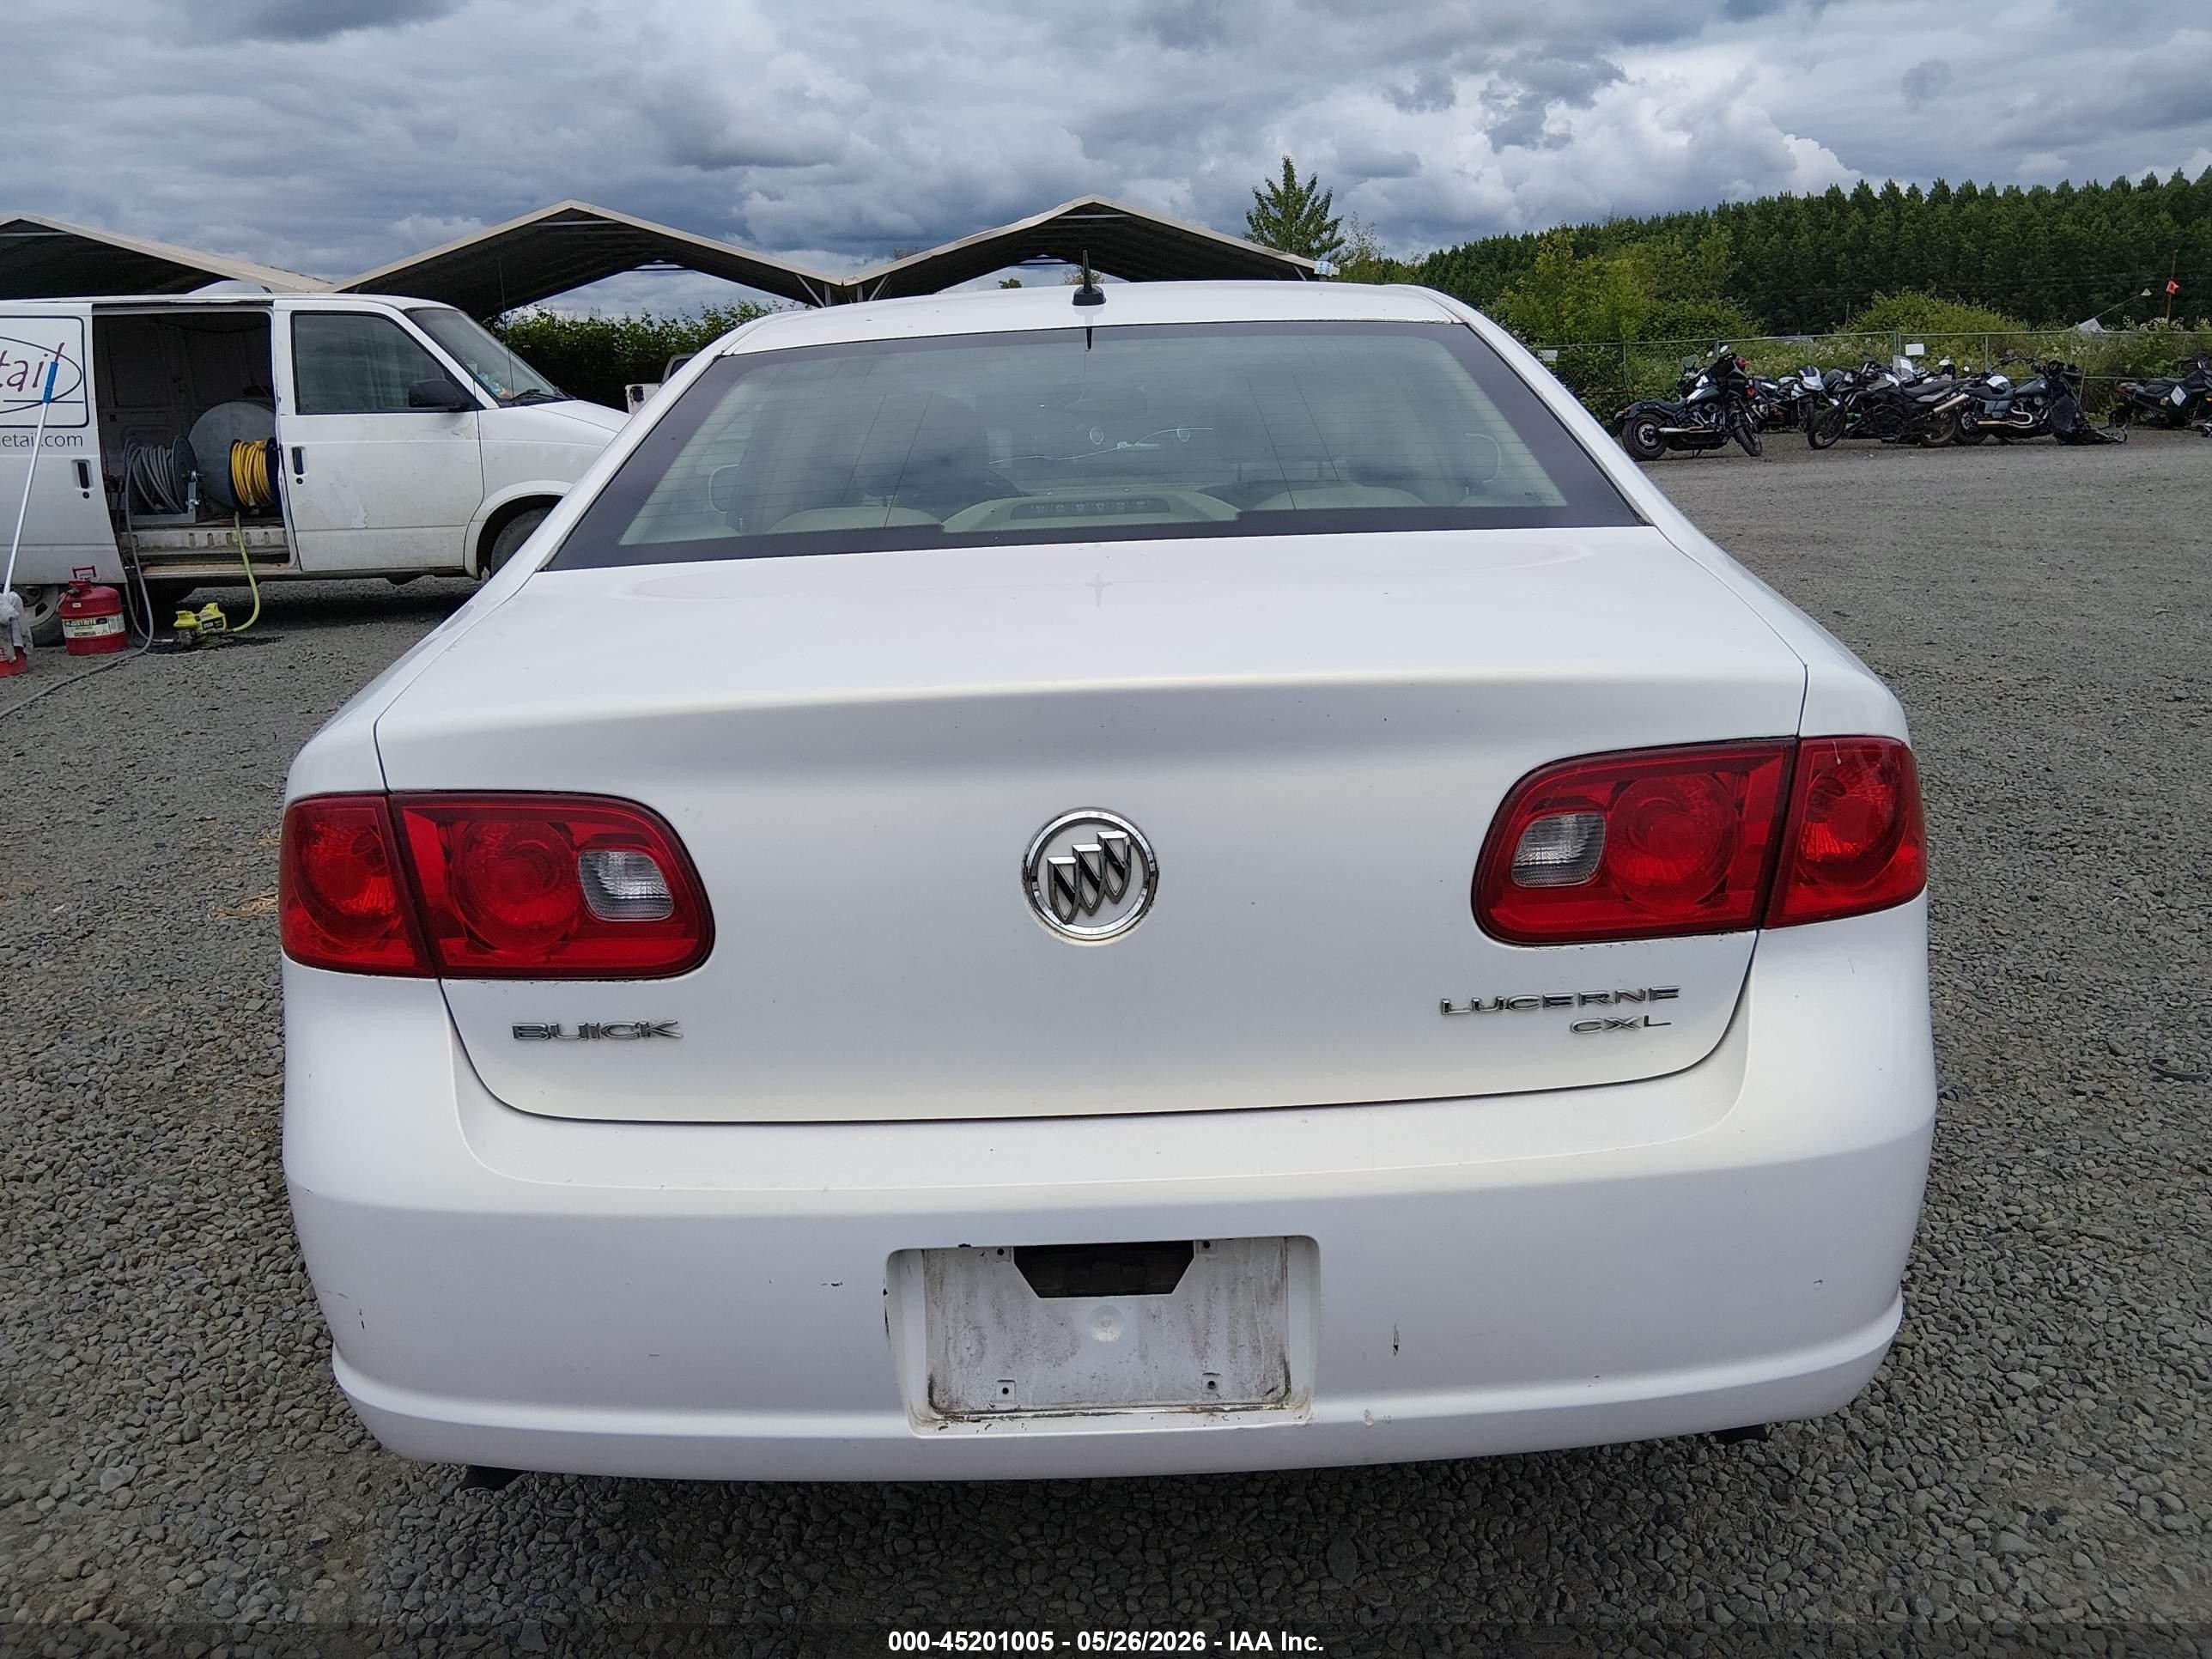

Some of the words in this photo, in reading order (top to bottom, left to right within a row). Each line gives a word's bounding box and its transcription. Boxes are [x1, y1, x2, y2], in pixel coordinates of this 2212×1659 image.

[0, 432, 83, 447] etai.com
[1441, 985, 1680, 1016] LUCERNE
[512, 1019, 684, 1041] BUICK
[1570, 1014, 1672, 1034] CXL
